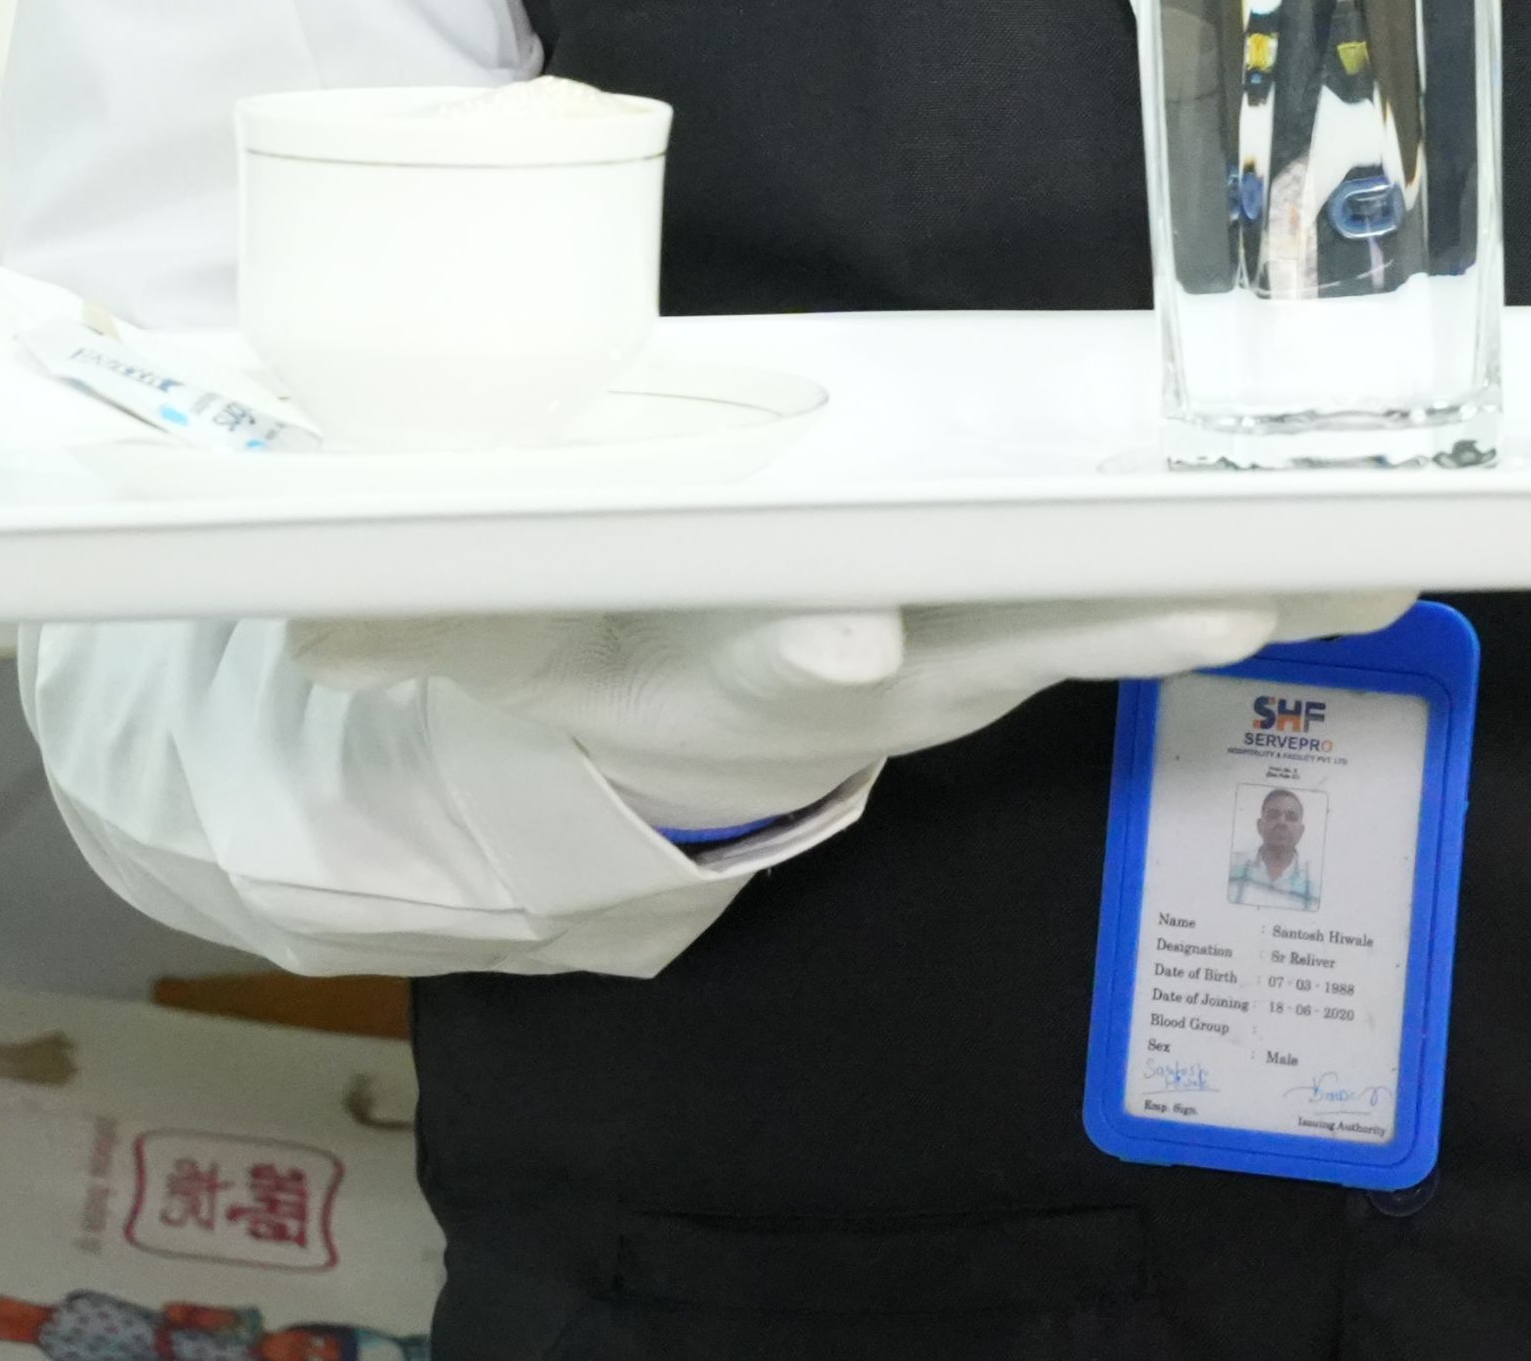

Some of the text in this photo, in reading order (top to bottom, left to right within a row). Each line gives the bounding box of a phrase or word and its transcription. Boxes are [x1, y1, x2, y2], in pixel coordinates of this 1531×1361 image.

[1252, 695, 1327, 733] SHF
[1243, 732, 1334, 753] SERVEPRO
[1158, 912, 1197, 929] Name
[1271, 924, 1325, 943] Santosh
[1328, 931, 1374, 948] Hiwale
[1156, 937, 1234, 958] Designation
[1153, 962, 1185, 979] Date
[1188, 967, 1202, 981] of
[1203, 967, 1238, 985] Birth
[1151, 987, 1183, 1004] Date
[1185, 990, 1199, 1005] of
[1200, 992, 1250, 1013] Joining
[1149, 1012, 1187, 1030] Blood
[1189, 1017, 1230, 1036] Group
[1146, 1037, 1171, 1054] Sex
[1265, 1050, 1300, 1067] Male
